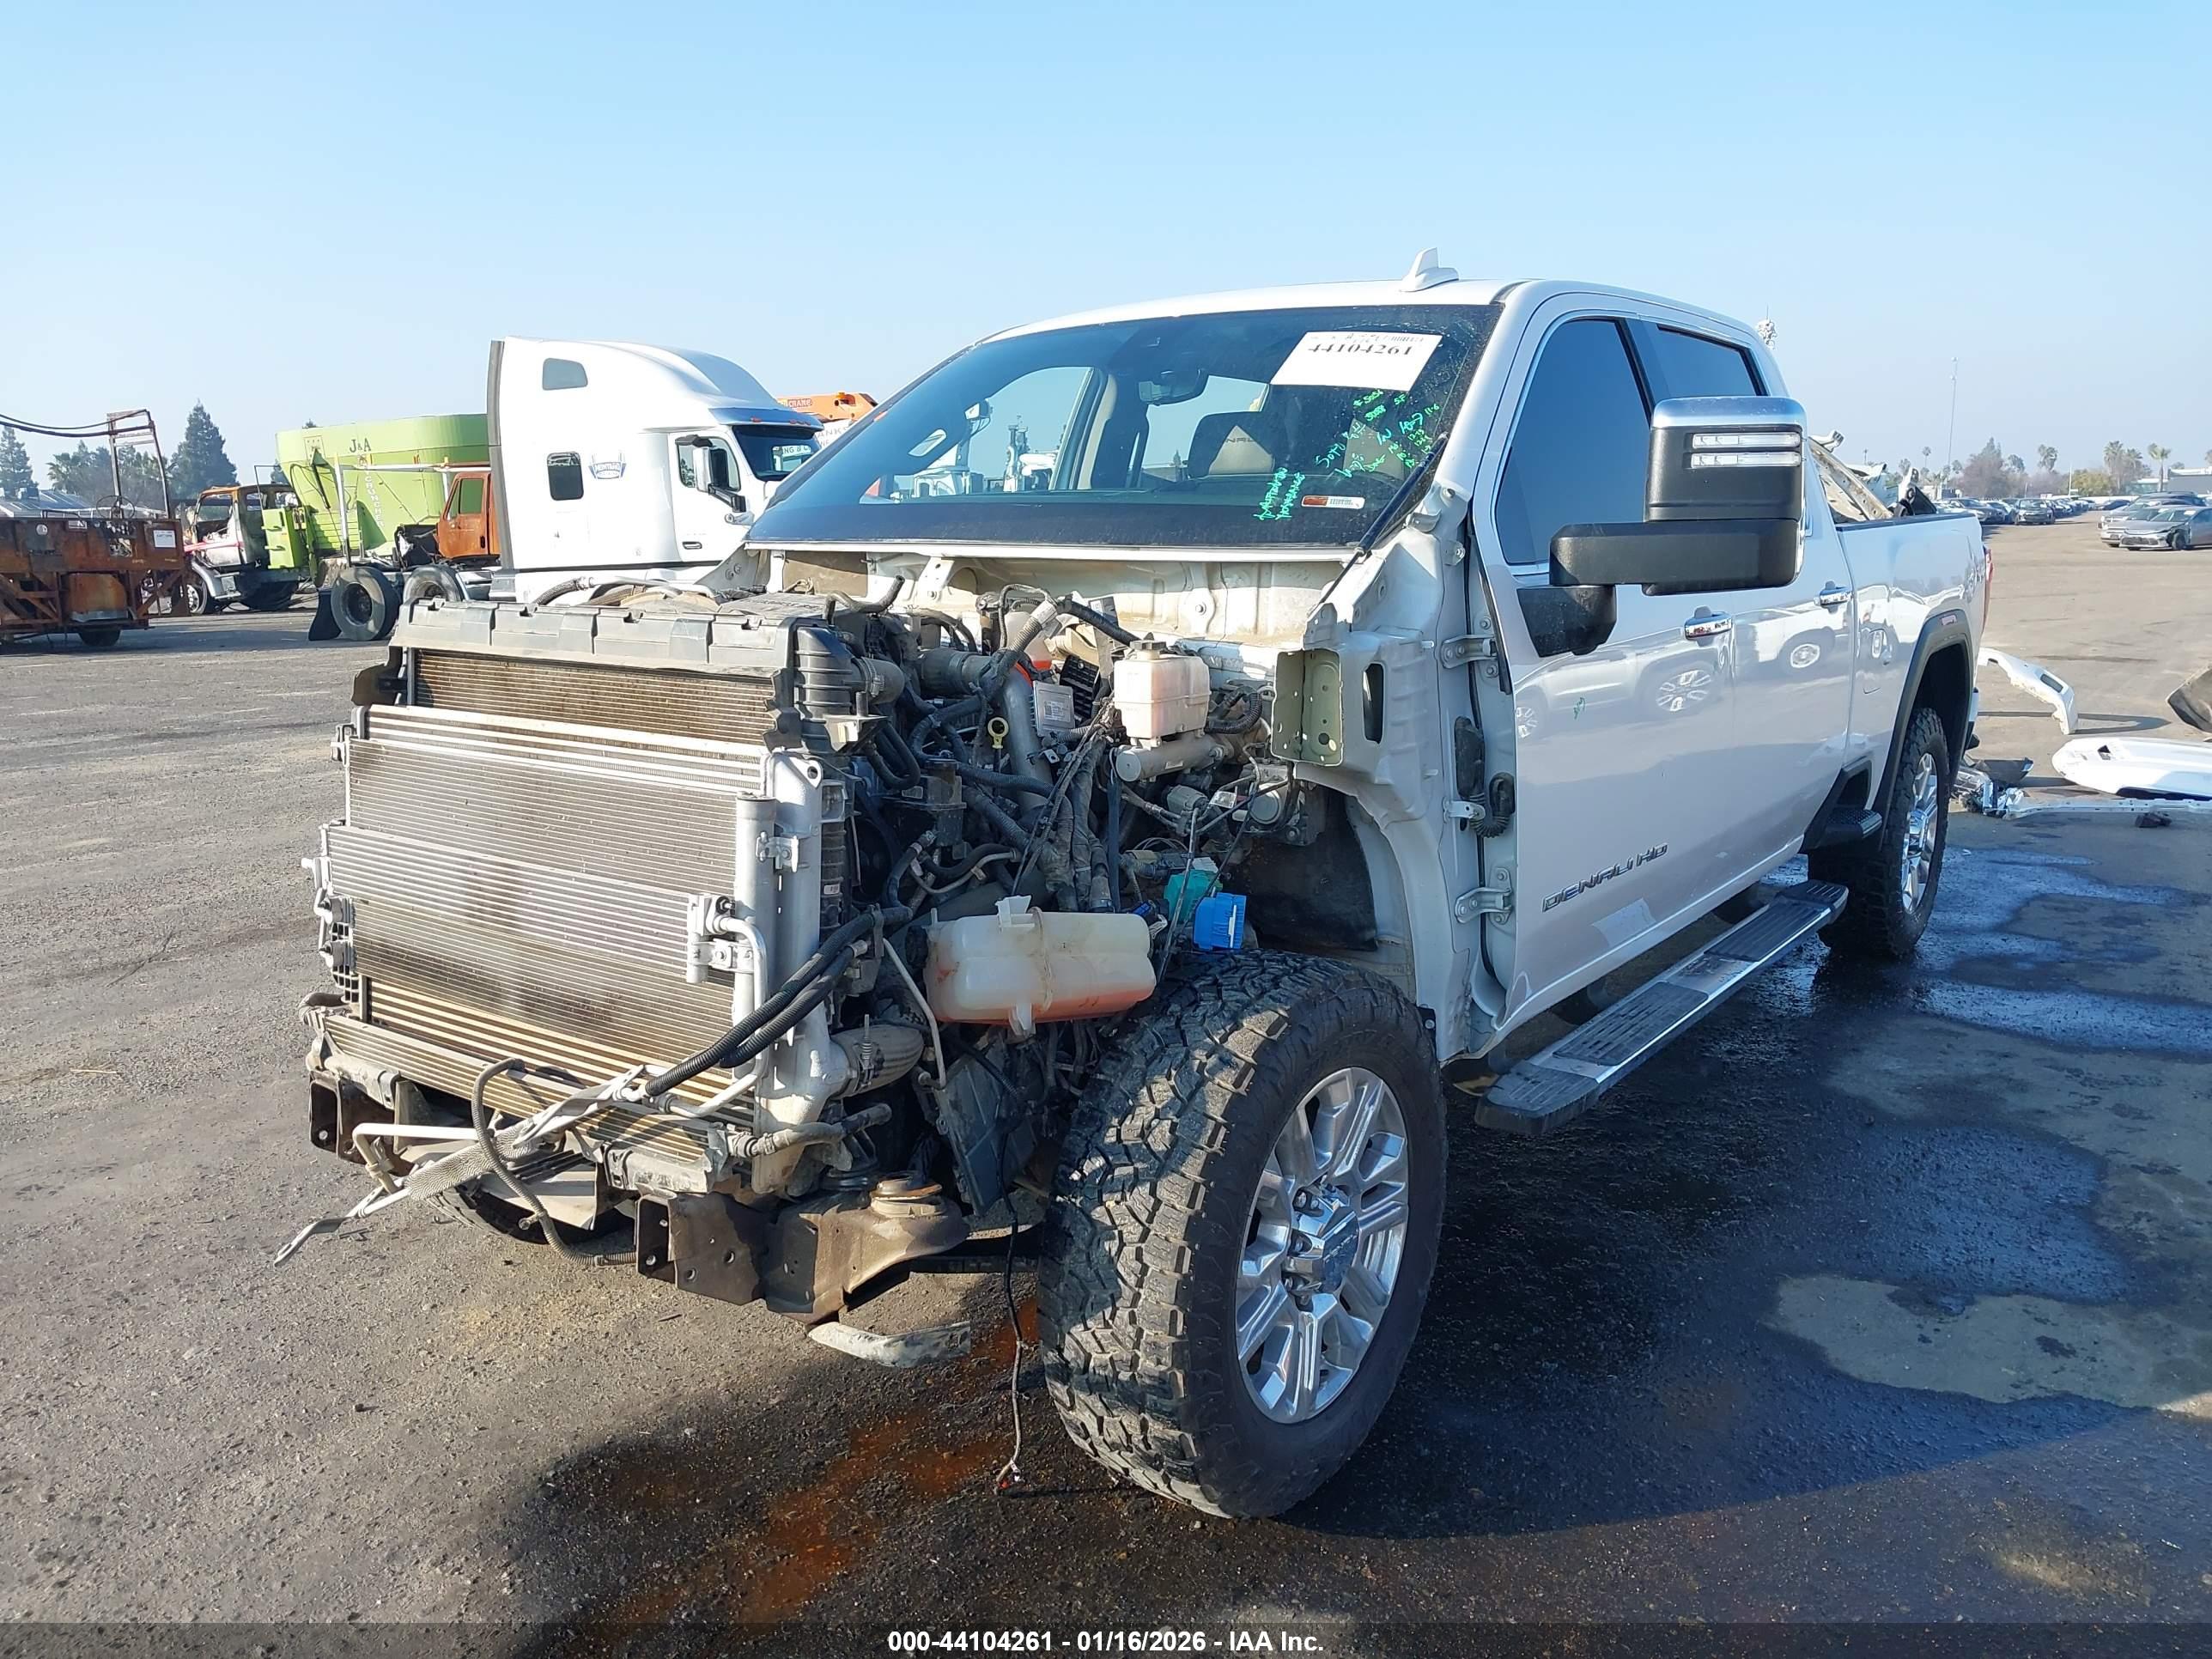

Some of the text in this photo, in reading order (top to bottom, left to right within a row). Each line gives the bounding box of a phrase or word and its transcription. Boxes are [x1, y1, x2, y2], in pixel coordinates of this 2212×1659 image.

[1308, 343, 1413, 355] 44104261
[349, 438, 372, 453] J&A
[1542, 842, 1669, 913] DENALI HD
